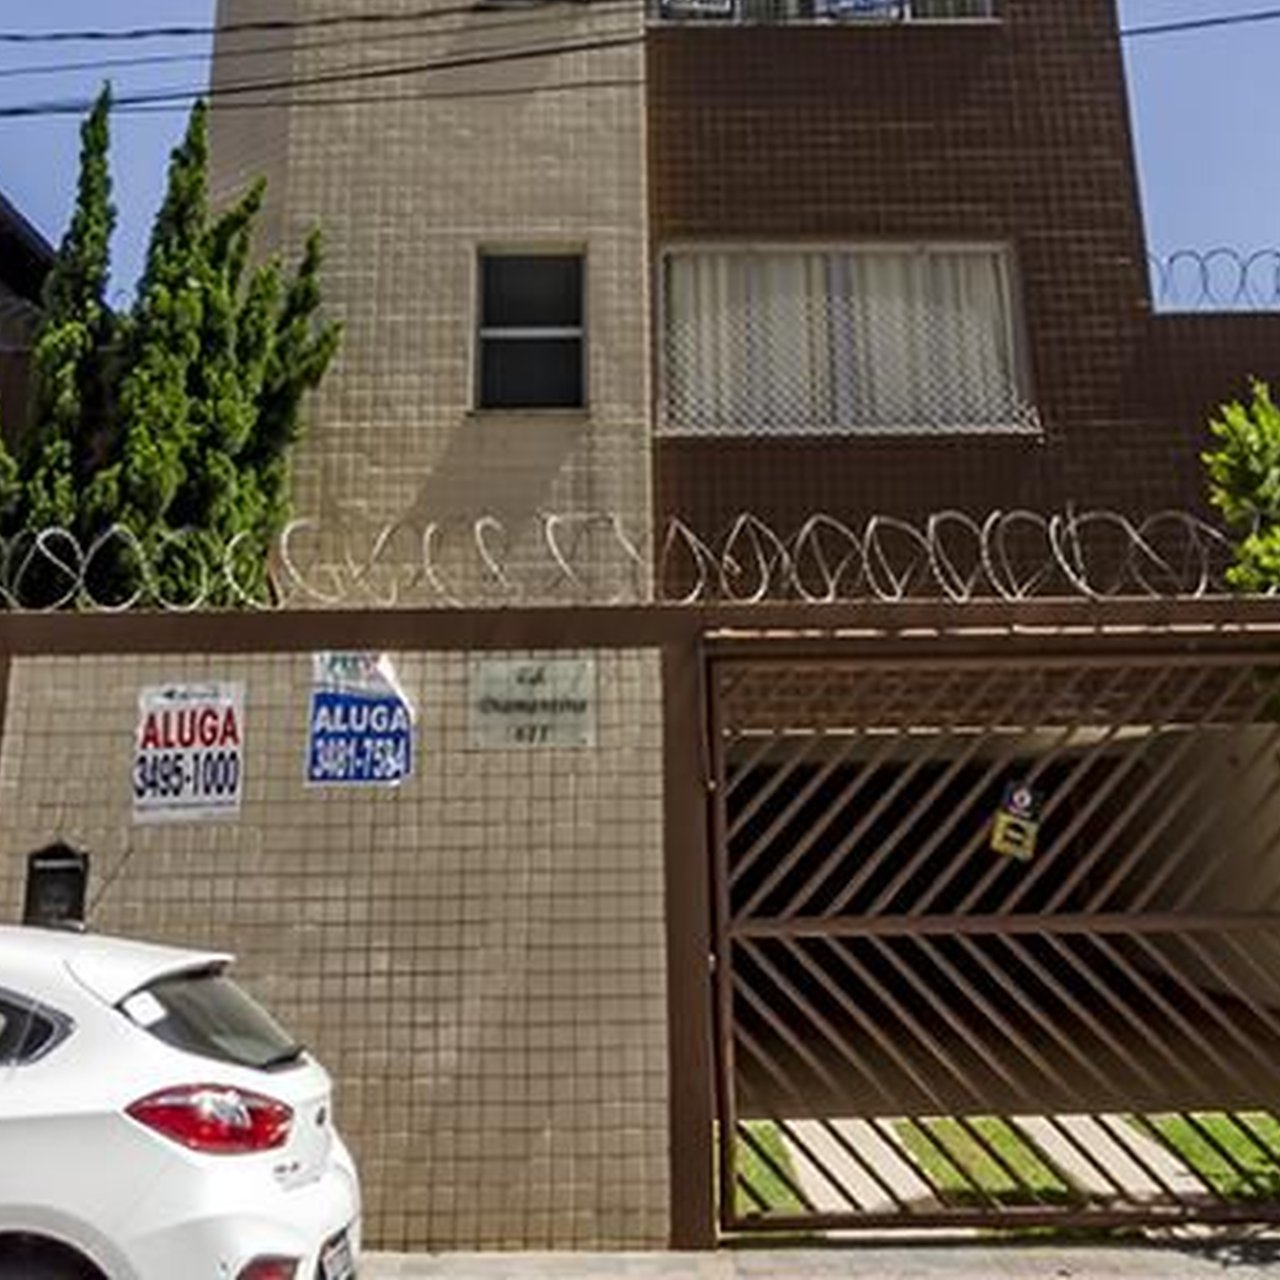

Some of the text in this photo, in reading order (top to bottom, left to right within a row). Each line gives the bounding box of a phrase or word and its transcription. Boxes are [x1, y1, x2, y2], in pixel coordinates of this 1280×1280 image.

[141, 706, 240, 749] ALUGA
[313, 705, 408, 732] ALUGA
[134, 751, 240, 798] 3495-1000
